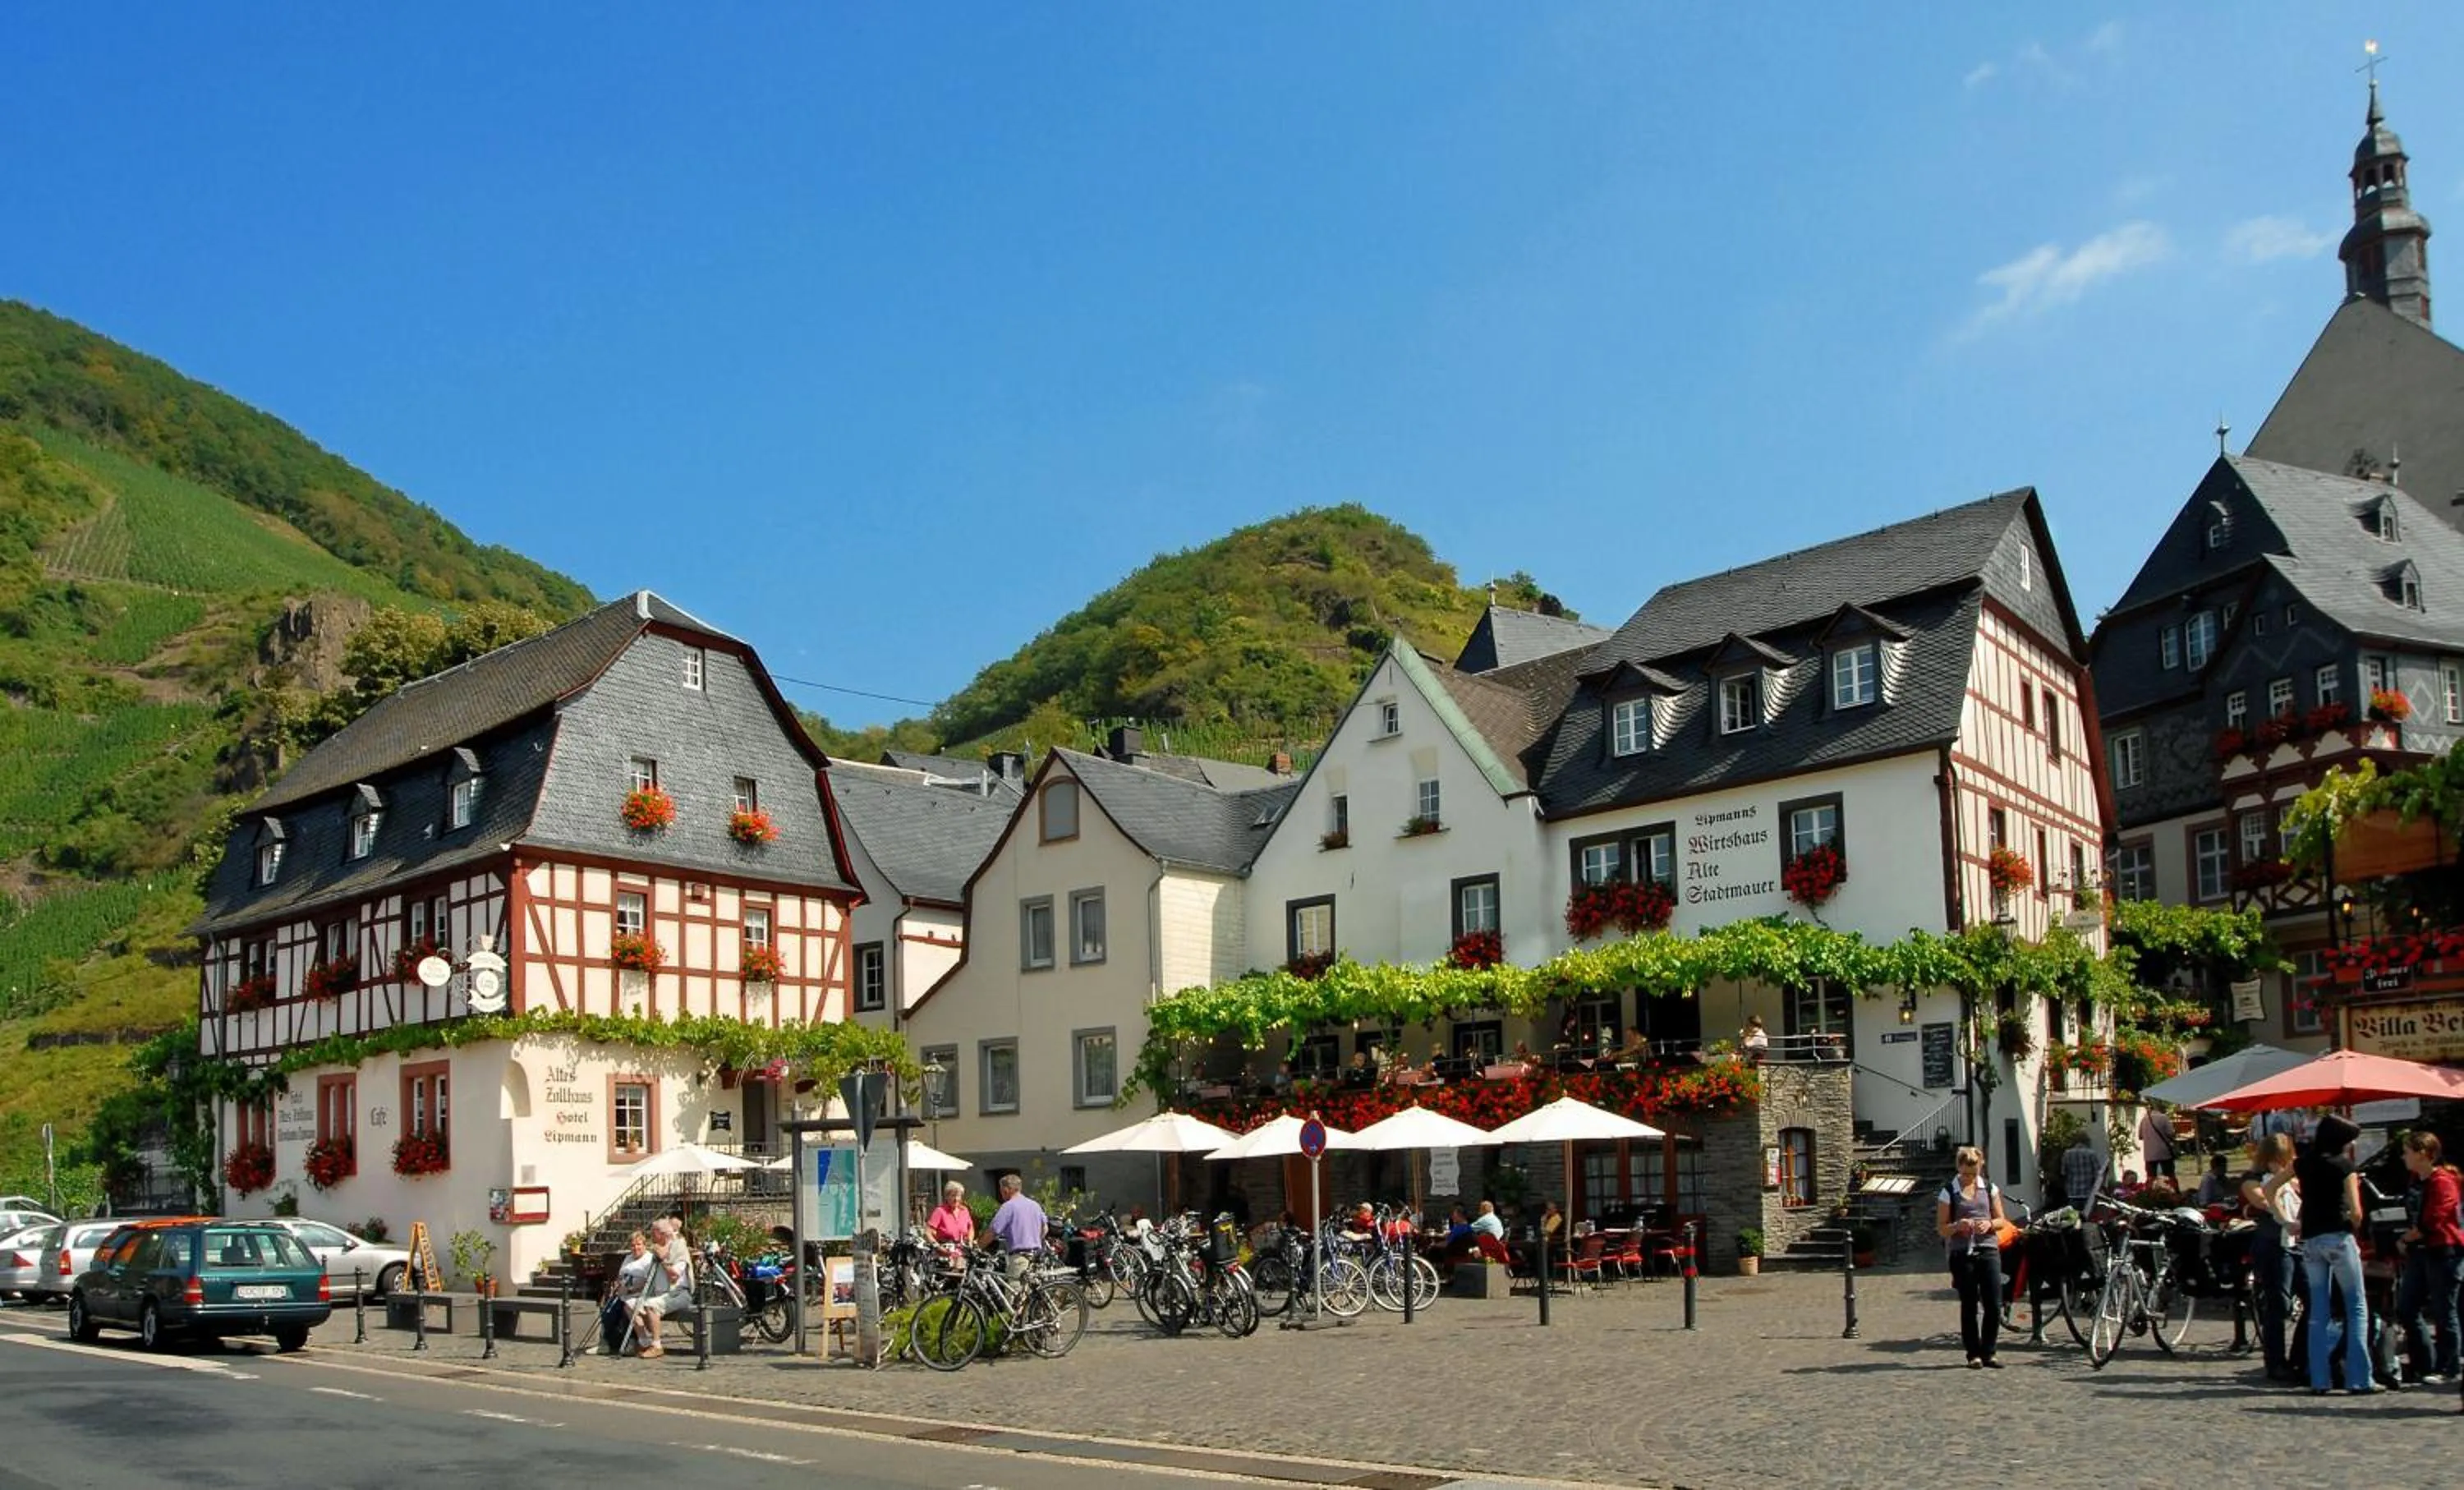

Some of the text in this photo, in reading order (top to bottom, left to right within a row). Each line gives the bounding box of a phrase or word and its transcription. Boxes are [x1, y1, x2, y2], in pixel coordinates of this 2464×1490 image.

[1695, 805, 1758, 826] Lipmanns
[1688, 830, 1768, 855] Wirtshaus
[1686, 862, 1719, 881] Alte
[1685, 880, 1775, 904] Stadtmauer
[2377, 976, 2398, 989] frei
[2355, 1016, 2417, 1038] Villa
[545, 1065, 577, 1083] Altes
[545, 1086, 593, 1103] Zollhaus
[556, 1111, 588, 1124] Hotel
[544, 1129, 597, 1144] Lipmann
